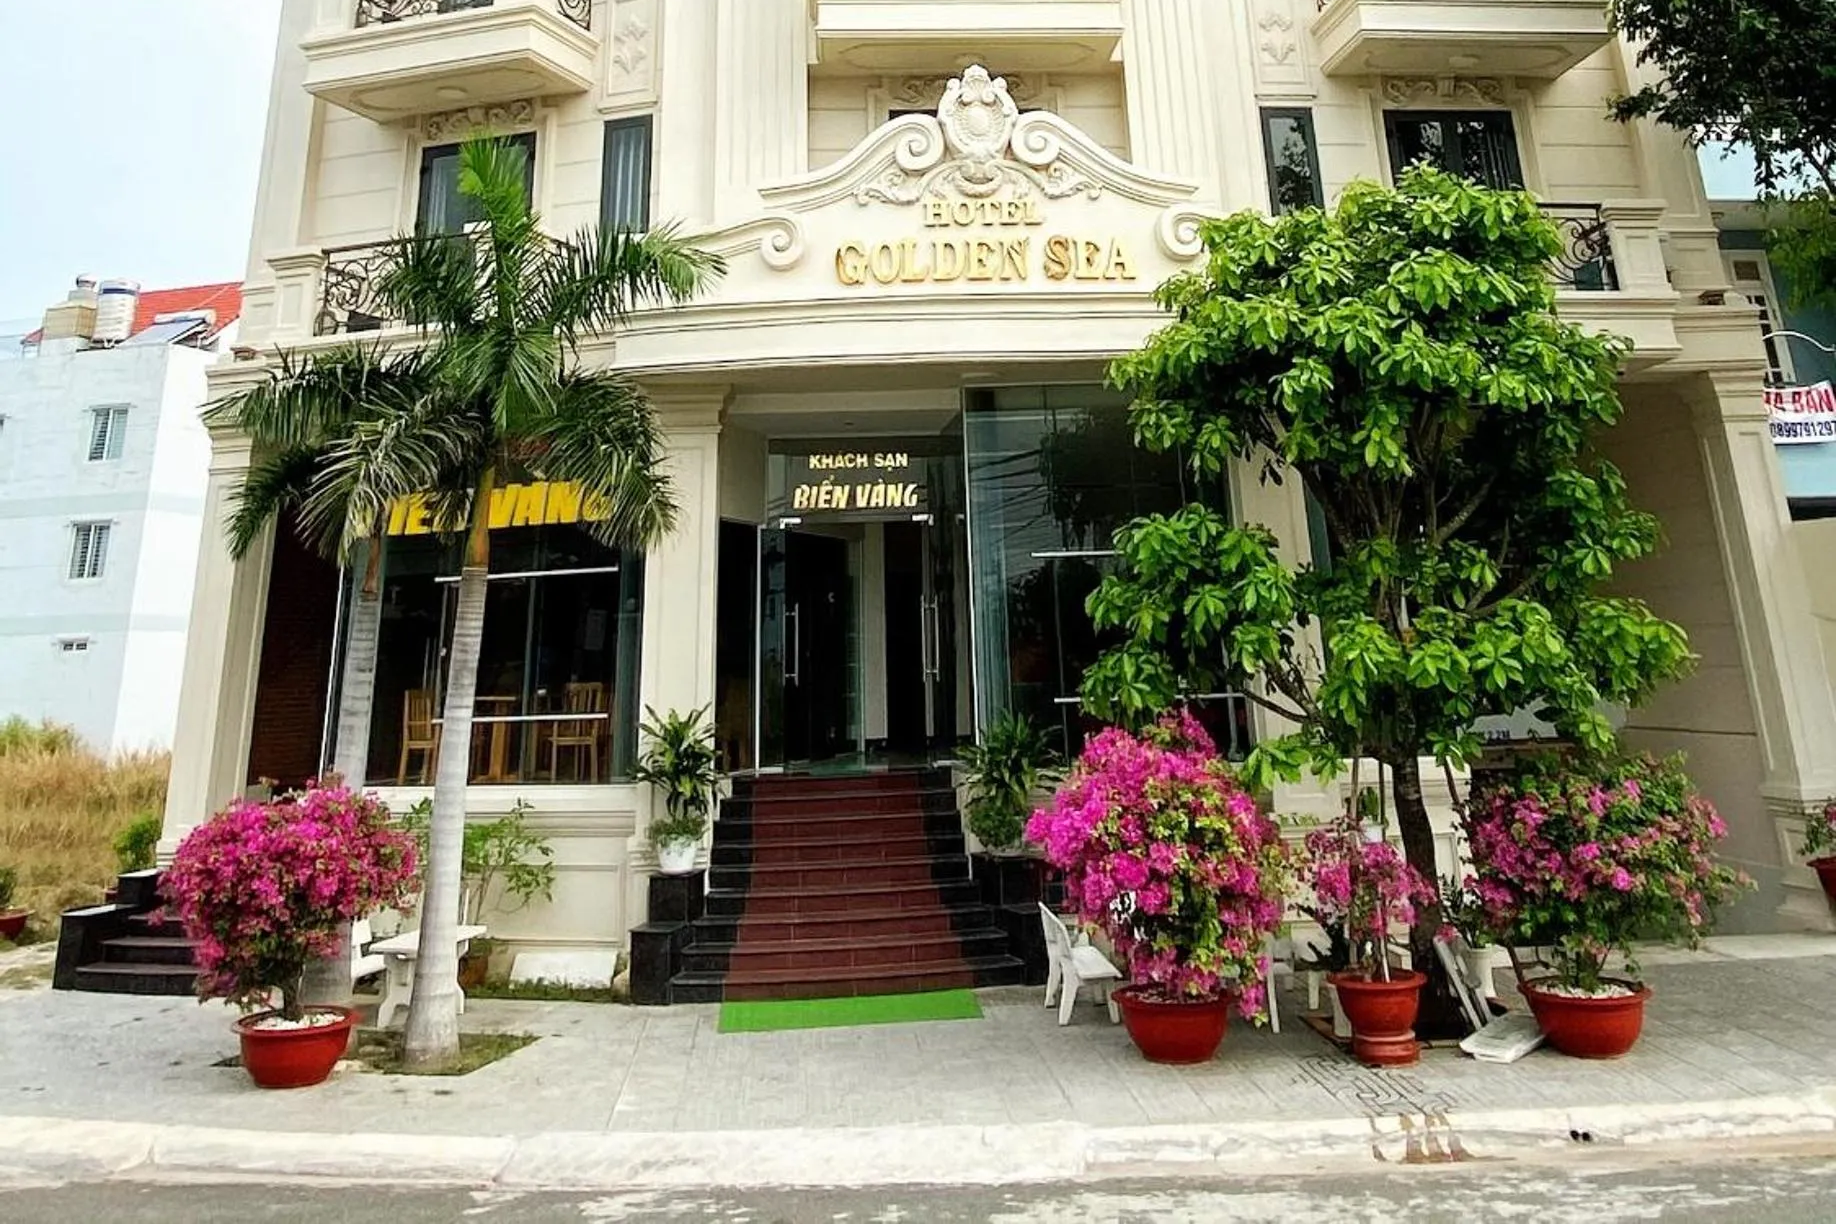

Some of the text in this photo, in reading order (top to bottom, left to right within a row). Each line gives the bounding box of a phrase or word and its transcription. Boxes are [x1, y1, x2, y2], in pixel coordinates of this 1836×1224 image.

[923, 200, 1046, 227] HOTEL
[835, 234, 1137, 286] GOLDEN SEA
[874, 452, 908, 472] SẠN
[855, 478, 919, 509] VÀNG
